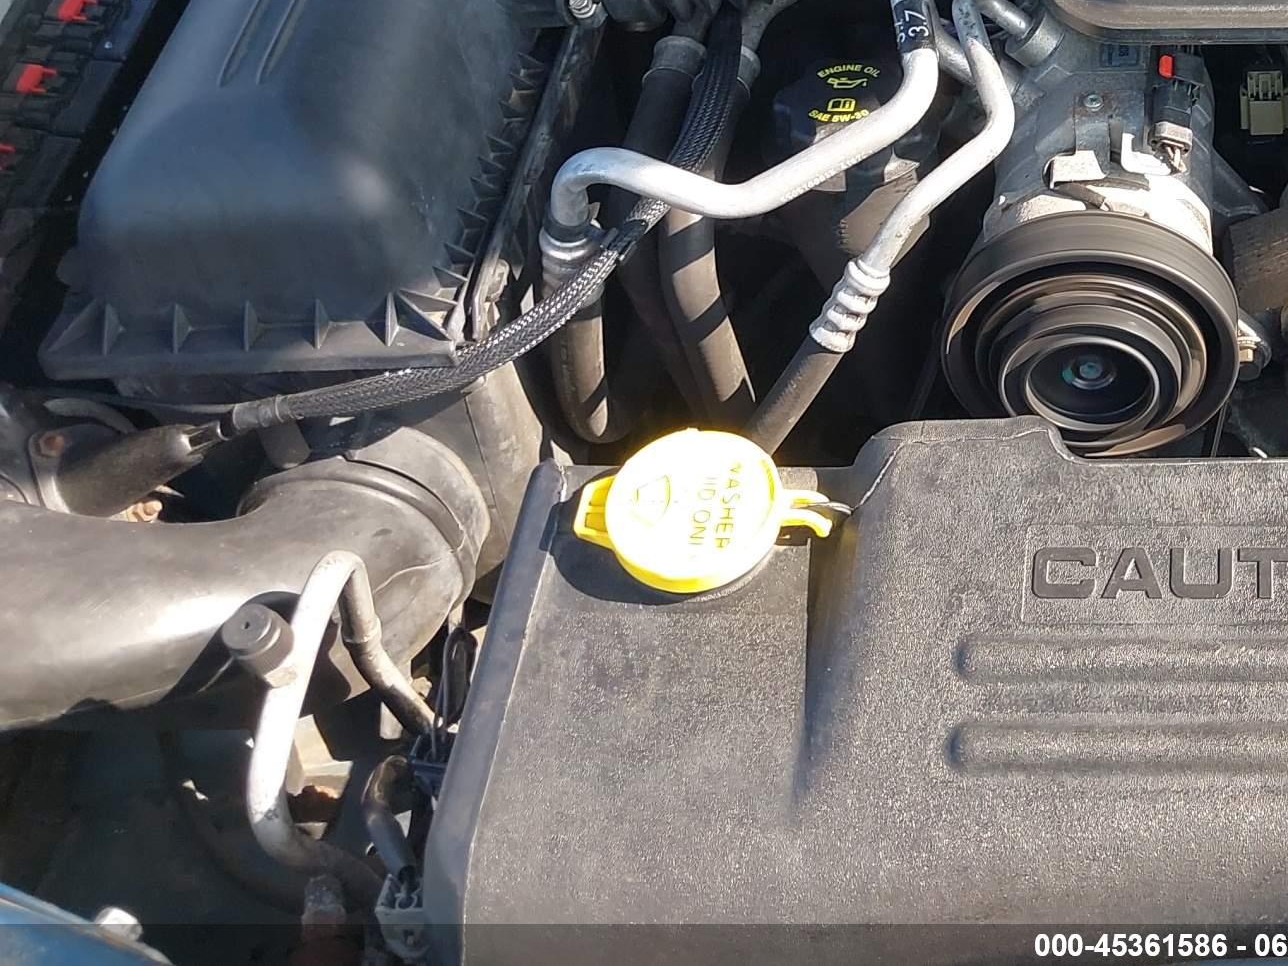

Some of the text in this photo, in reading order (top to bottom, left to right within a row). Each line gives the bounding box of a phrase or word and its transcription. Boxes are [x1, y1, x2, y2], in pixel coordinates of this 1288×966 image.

[904, 9, 930, 38] 3.7
[816, 63, 882, 79] ENGINE OIL
[808, 109, 829, 122] SAE
